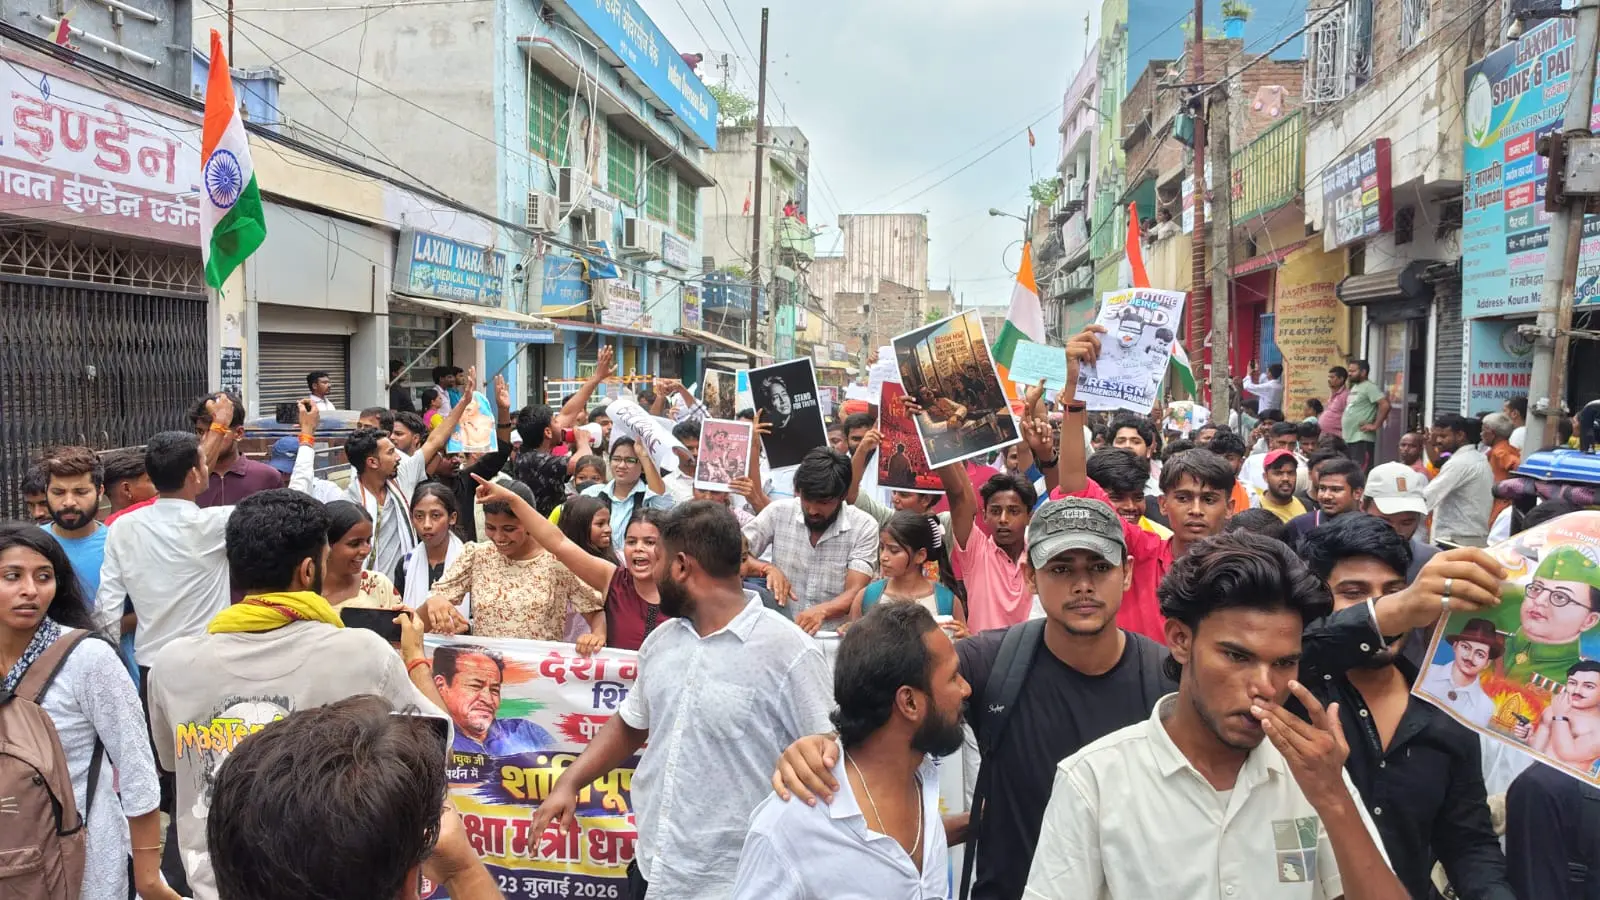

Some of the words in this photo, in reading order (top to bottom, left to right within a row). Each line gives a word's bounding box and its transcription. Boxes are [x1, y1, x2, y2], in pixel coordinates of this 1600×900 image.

[1515, 21, 1560, 67] LAXMI
[667, 56, 683, 91] Indian
[699, 92, 709, 122] Bank
[1492, 70, 1531, 106] SPINE
[11, 91, 182, 184] इण्डेन
[1475, 160, 1503, 188] नागमणि
[1475, 188, 1502, 211] Nagmani
[414, 235, 455, 266] LAXMI
[435, 267, 465, 285] MEDICAL
[465, 274, 481, 288] HALL
[1477, 299, 1506, 309] Address-
[1508, 294, 1529, 307] Koura
[1087, 377, 1145, 396] RESIGN
[1472, 372, 1509, 388] LAXMI
[793, 392, 811, 403] STAND
[793, 402, 802, 410] FOR
[801, 398, 817, 409] TRUTH
[1472, 389, 1493, 400] SPINE
[1495, 389, 1510, 401] AND
[541, 651, 609, 685] देश
[472, 755, 485, 767] जी
[470, 767, 479, 780] में
[498, 875, 518, 893] 23
[522, 874, 571, 900] जुलाई
[574, 882, 618, 899] 2026
